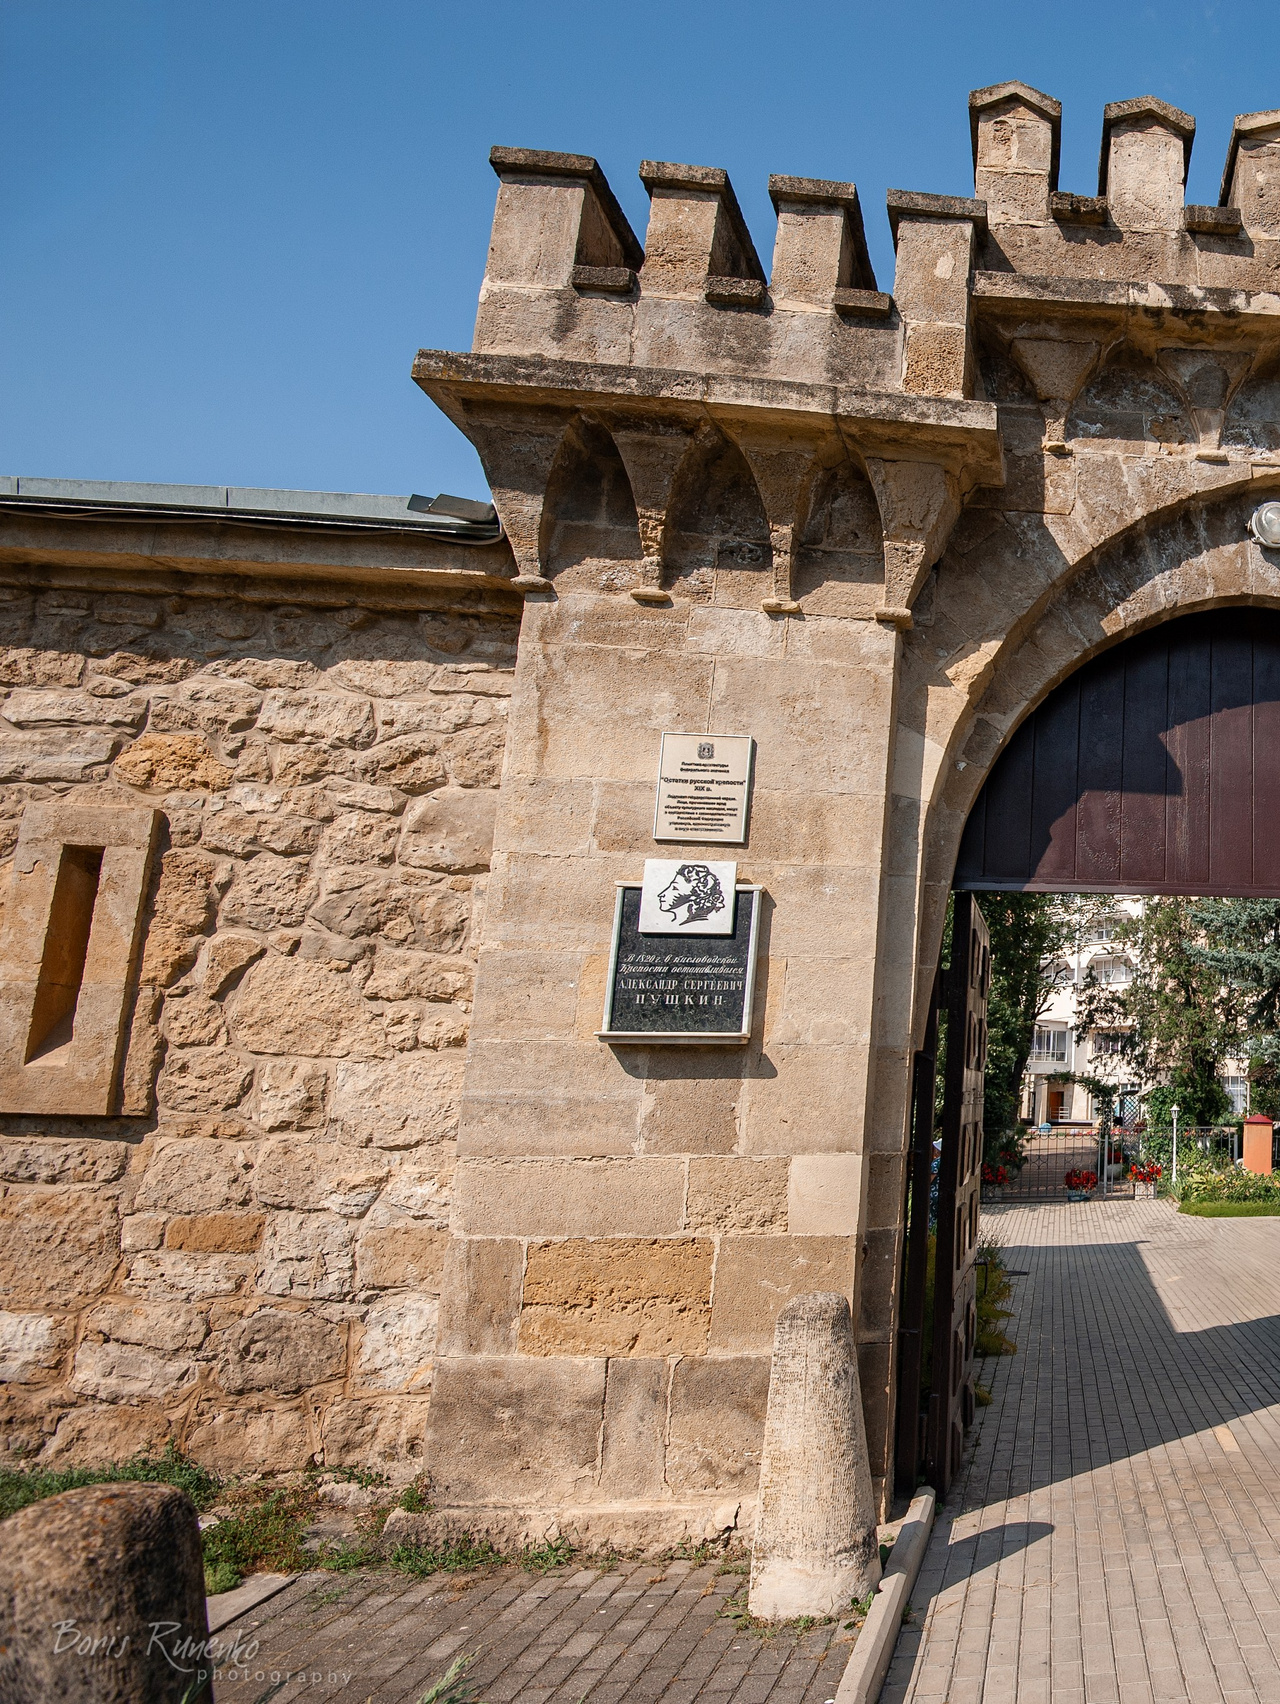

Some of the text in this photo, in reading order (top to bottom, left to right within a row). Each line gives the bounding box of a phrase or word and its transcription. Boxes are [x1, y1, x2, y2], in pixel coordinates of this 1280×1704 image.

[635, 953, 656, 963] 1820
[619, 979, 743, 991] АЛЕКСАНДР СЕРГЕЕВИЧ
[635, 994, 723, 1005] ПУШКИН
